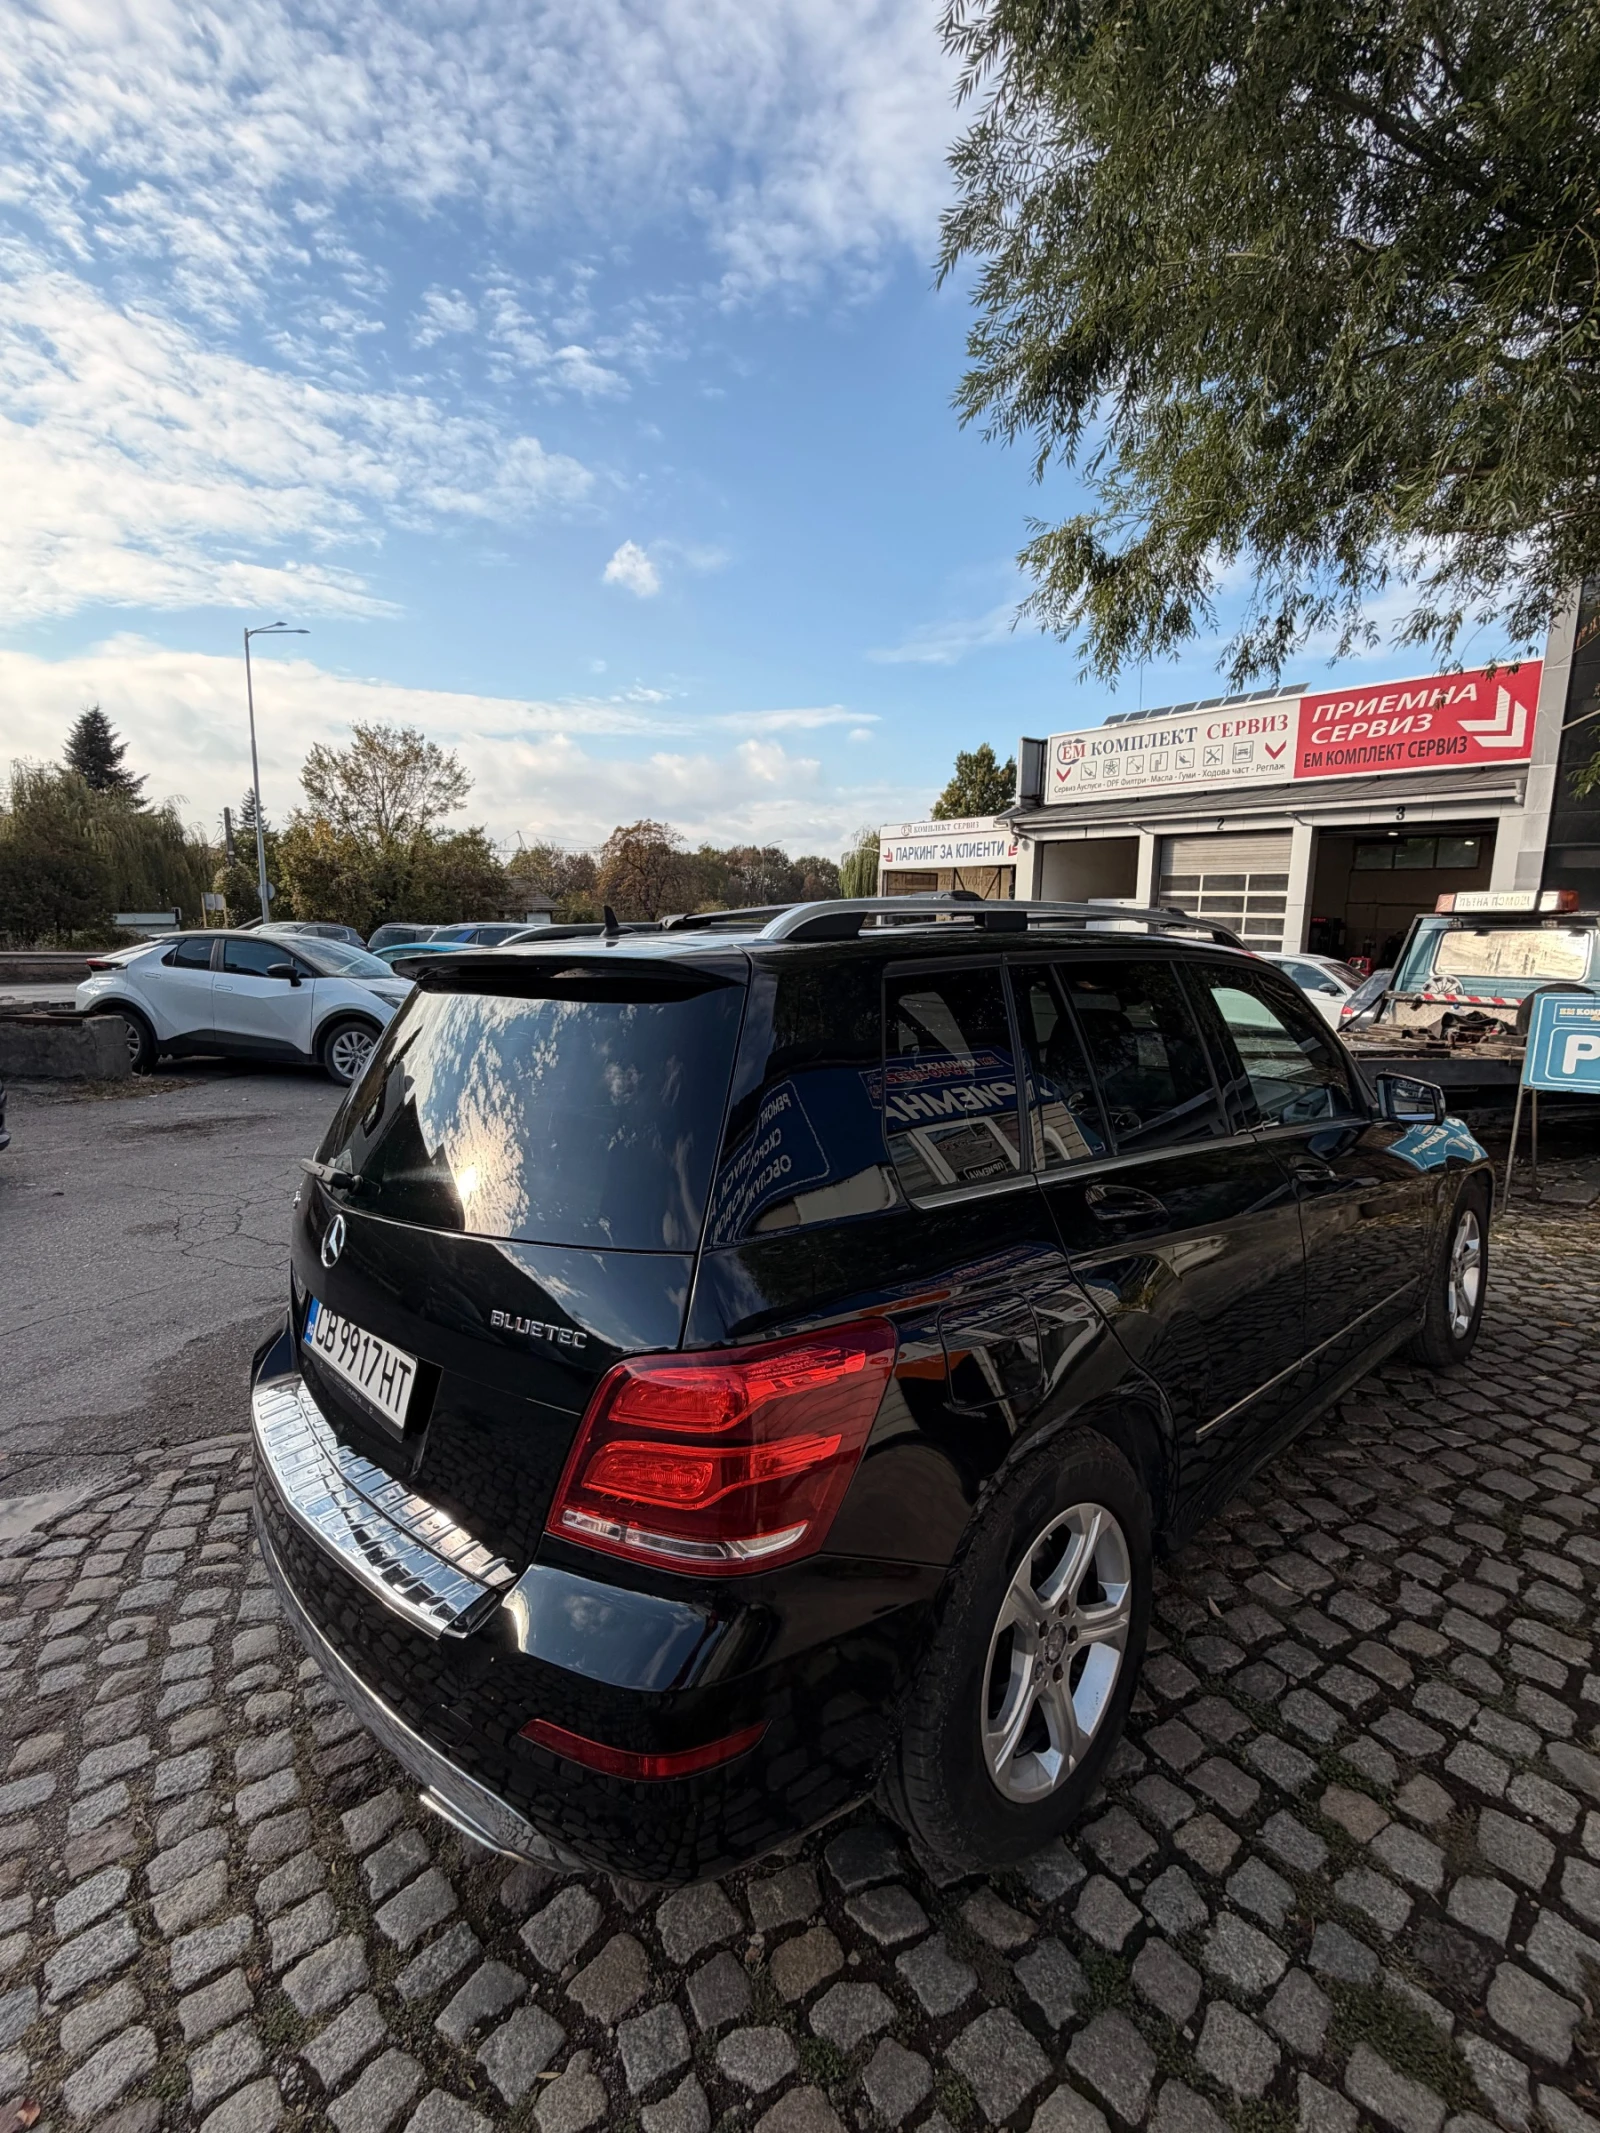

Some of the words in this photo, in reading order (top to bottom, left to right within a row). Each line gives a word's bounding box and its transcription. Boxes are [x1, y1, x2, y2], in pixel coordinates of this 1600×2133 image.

[1311, 682, 1477, 723] ПРИЕМНА
[1062, 743, 1086, 760] ЕМ
[1090, 727, 1198, 757] КОМПЛЕКТ
[1207, 714, 1288, 740] СЕРВИЗ
[1310, 713, 1433, 744] СЕРВИЗ
[1303, 752, 1323, 768] ЕМ
[1325, 742, 1405, 765] КОМПЛЕКТ
[1407, 735, 1468, 759] СЕРВИЗ
[1054, 784, 1076, 794] Сервиз
[1106, 780, 1119, 788] DPF
[1120, 778, 1147, 788] Филтри
[1150, 775, 1173, 783] Масла
[1178, 772, 1196, 781] Гуми
[1202, 768, 1230, 778] Ходова
[1232, 766, 1249, 774] част
[1256, 763, 1286, 773] Реглаж
[913, 823, 951, 834] КОМПЛЕКТ
[953, 821, 979, 830] СЕРВИЗ
[1217, 818, 1225, 830] 2
[1396, 806, 1406, 821] 3
[1083, 826, 1088, 838] 1
[896, 845, 938, 861] ПАРКИНГ
[940, 843, 953, 860] ЗА
[956, 840, 1005, 859] КЛИЕНТИ
[1562, 1034, 1600, 1074] P
[490, 1309, 588, 1348] BLUETEC
